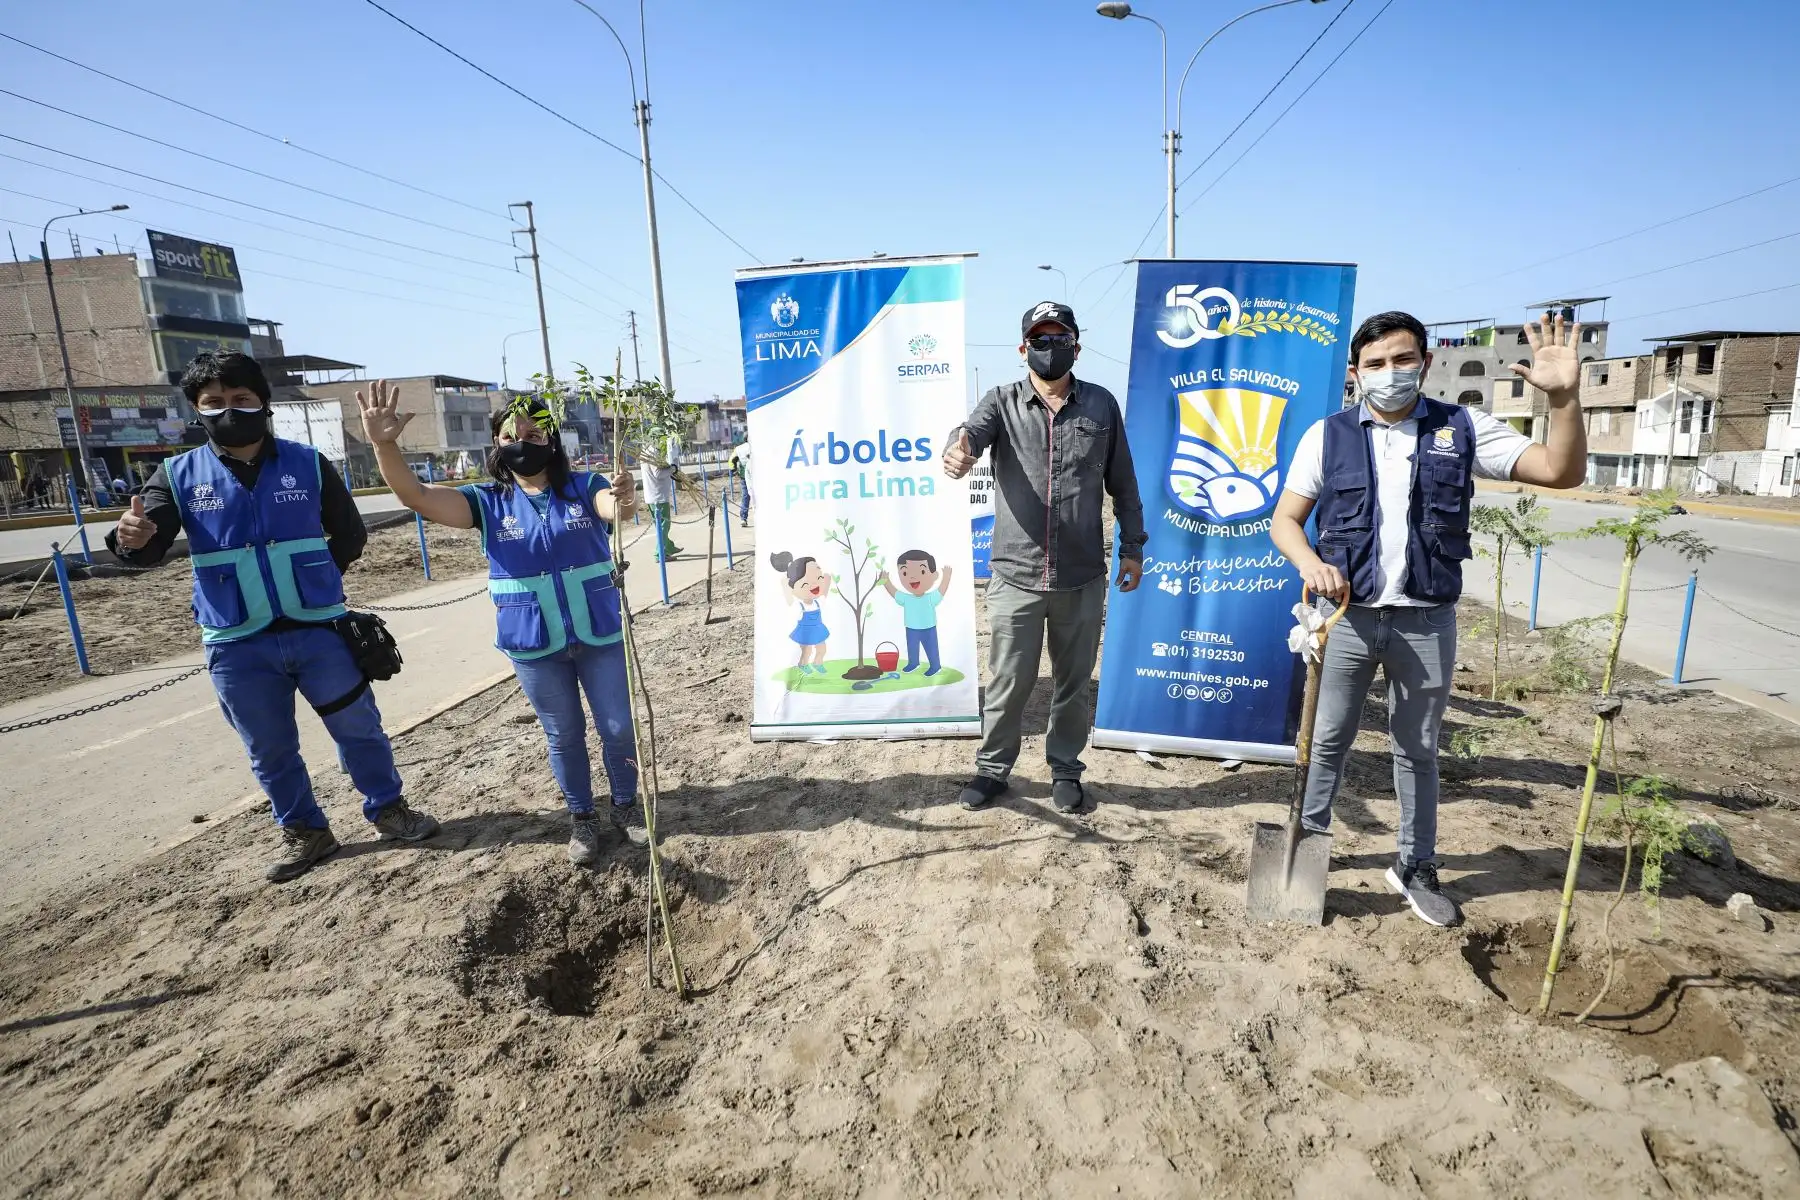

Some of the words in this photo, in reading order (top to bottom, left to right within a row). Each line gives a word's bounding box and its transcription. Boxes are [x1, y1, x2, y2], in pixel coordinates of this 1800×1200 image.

[1156, 284, 1240, 348] 50
[1207, 304, 1229, 316] años
[1240, 299, 1252, 308] de
[1253, 298, 1287, 309] historia
[1287, 303, 1296, 312] y
[1296, 302, 1340, 326] desarrollo
[755, 329, 809, 340] MUNICIPALIDAD
[810, 328, 820, 336] DE
[756, 340, 822, 361] LIMA
[897, 363, 950, 376] SERPAR
[1169, 370, 1207, 389] VILLA
[1211, 368, 1225, 382] EL
[1229, 368, 1300, 396] SALVADOR
[785, 429, 932, 469] Árboles
[275, 493, 309, 503] LIMA
[785, 479, 849, 511] para
[859, 470, 935, 498] Lima
[187, 499, 225, 508] SERPAR
[566, 521, 593, 531] LIMA
[1163, 508, 1272, 538] MUNICIPALIDAD
[1142, 550, 1287, 575] Construyendo
[1188, 574, 1289, 595] Bienestar
[1180, 630, 1234, 645] CENTRAL
[1167, 645, 1189, 658] (01)
[1192, 646, 1245, 663] 3192530
[1136, 667, 1269, 689] www.munives.gob.pe
